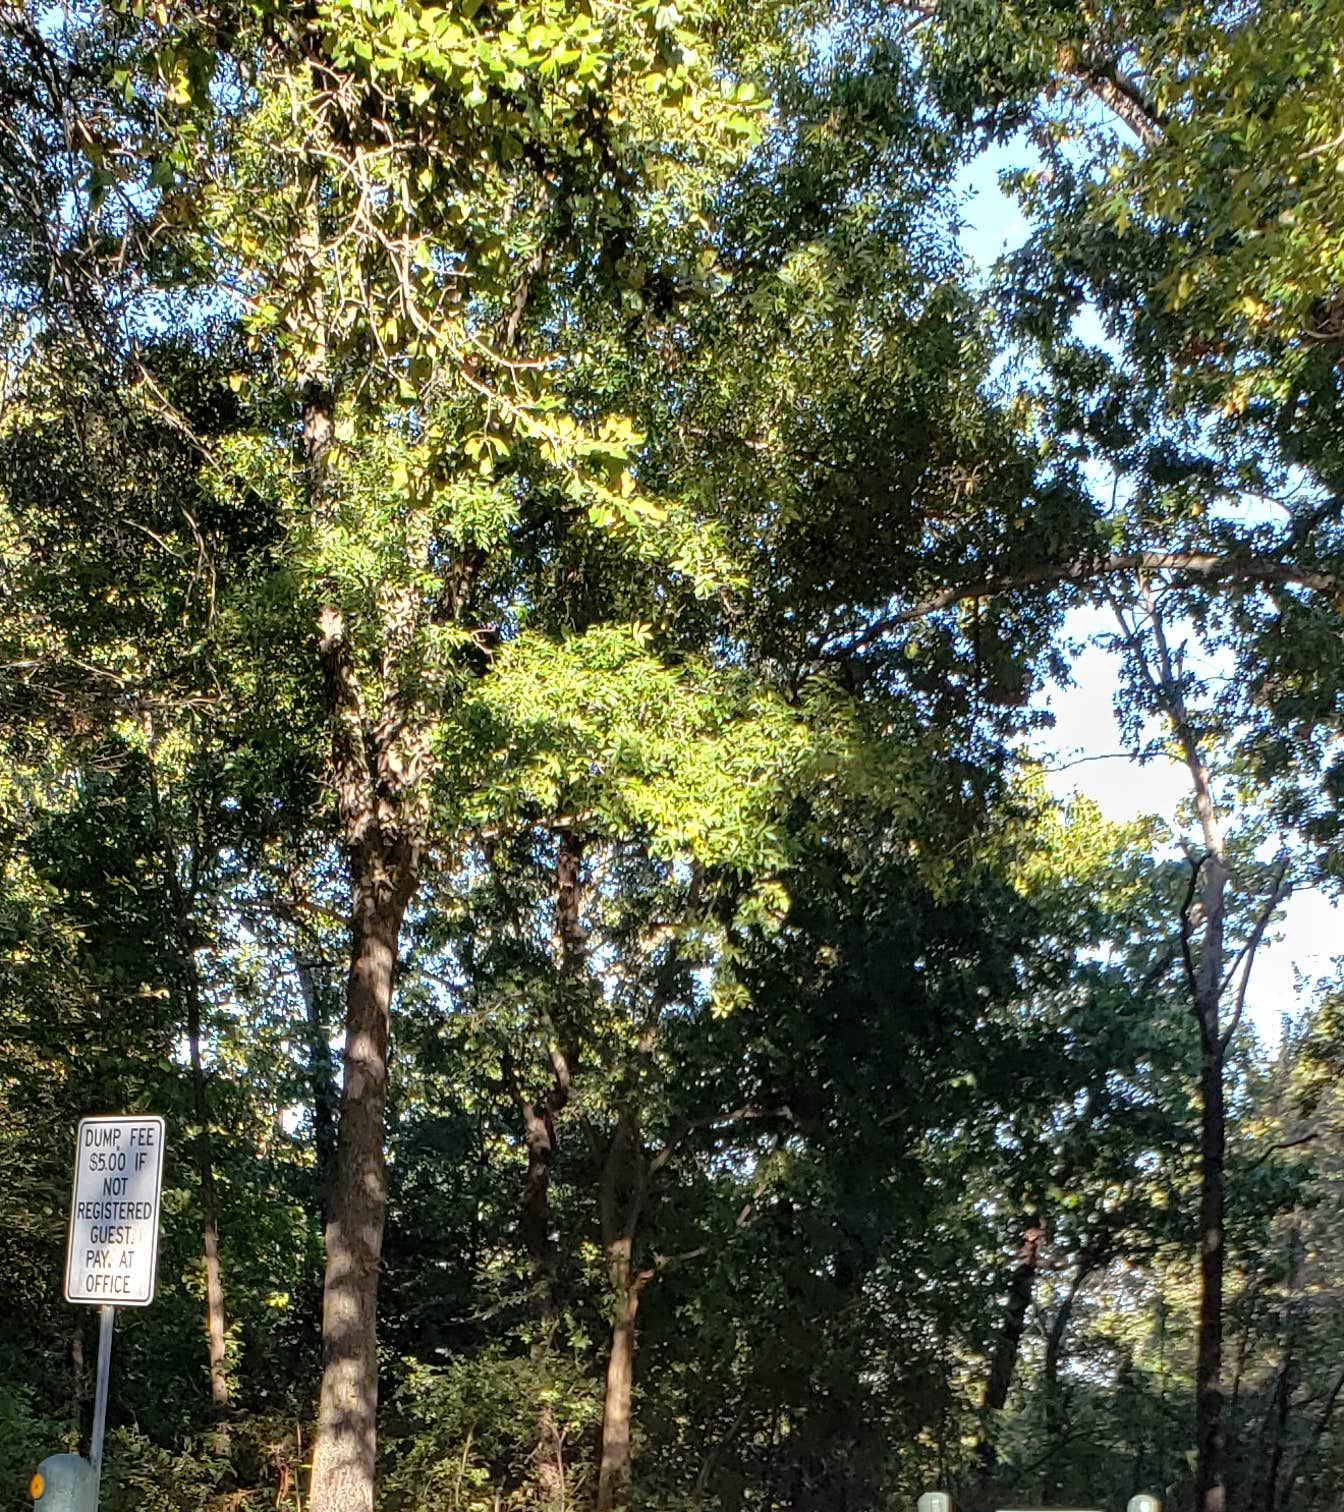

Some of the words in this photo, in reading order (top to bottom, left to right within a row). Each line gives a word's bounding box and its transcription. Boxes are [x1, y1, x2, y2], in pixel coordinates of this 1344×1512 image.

[85, 1128, 121, 1147] DUMP
[130, 1127, 154, 1146] FEE
[89, 1152, 126, 1172] $5.00
[135, 1152, 147, 1171] IF
[103, 1177, 128, 1196] NOT
[77, 1201, 152, 1220] REGISTERED
[90, 1226, 134, 1245] GUEST.
[119, 1251, 134, 1268] AT
[86, 1274, 131, 1293] OFFICE
